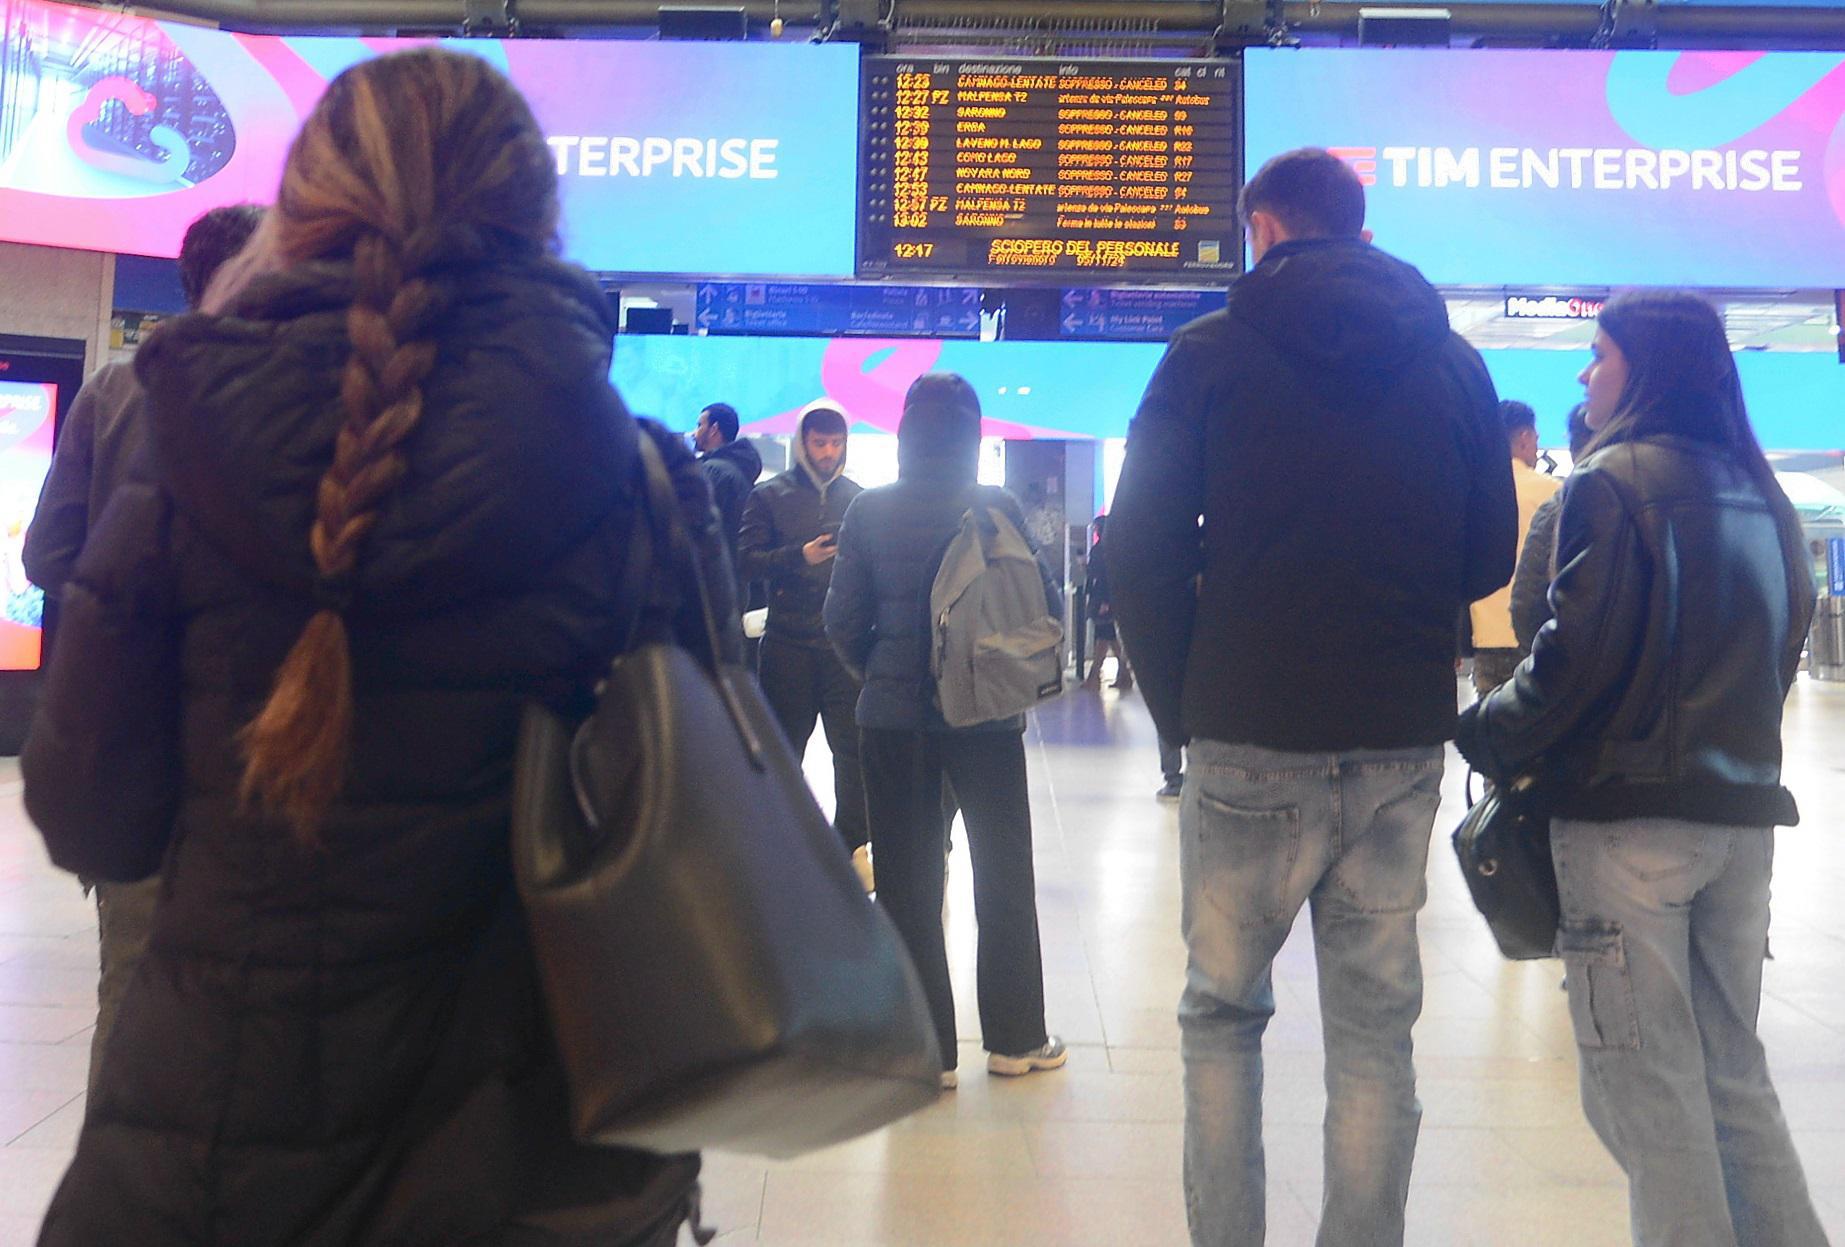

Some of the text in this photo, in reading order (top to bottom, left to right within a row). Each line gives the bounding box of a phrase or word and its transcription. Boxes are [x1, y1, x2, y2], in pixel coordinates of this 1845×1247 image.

[933, 63, 949, 74] bin
[958, 63, 1022, 74] destinazione
[896, 74, 930, 89] 12:23
[1059, 76, 1112, 90] SOPPRESSO
[1119, 77, 1167, 91] CANCELED
[896, 90, 929, 105] 12:27
[957, 91, 1012, 102] MALPENSA
[1175, 94, 1210, 106] Autobus
[895, 106, 930, 119] 12:32
[956, 107, 1006, 118] SARONNO
[1058, 109, 1113, 121] SOPPRESSO
[1119, 110, 1168, 121] CANCELED
[956, 122, 986, 133] ERBA
[1058, 123, 1113, 135] SOPPRESSO
[1119, 124, 1168, 136] CANCELED
[956, 138, 998, 149] LAVENO
[1013, 138, 1042, 150] LAGO
[1057, 139, 1113, 151] SOPPRESSO
[1119, 140, 1168, 152] CANCELED
[546, 135, 779, 179] TERPRISE
[895, 151, 929, 166] 12:43
[956, 152, 987, 163] COMO
[988, 152, 1017, 163] LAGO
[1058, 154, 1113, 167] SOPPRESSO
[1119, 155, 1168, 168] CANCELED
[895, 167, 928, 181] 12:47
[956, 167, 1001, 179] NOVARA
[1002, 168, 1032, 179] NORD
[1058, 169, 1113, 181] SOPPRESSO
[1119, 171, 1168, 182] CANCELED
[1382, 146, 1802, 191] TIM ENTERPRISE
[894, 182, 928, 197] 12:53
[1058, 185, 1113, 198] SOPPRESSO
[1119, 186, 1168, 199] CANCELED
[955, 198, 1010, 211] MALPENSA
[1174, 203, 1210, 215] Autobus
[894, 212, 928, 227] 13:02
[955, 213, 1004, 227] SARONNO
[894, 243, 934, 258] 12:17
[990, 239, 1180, 257] SCIOPERO DEL PERSONALE
